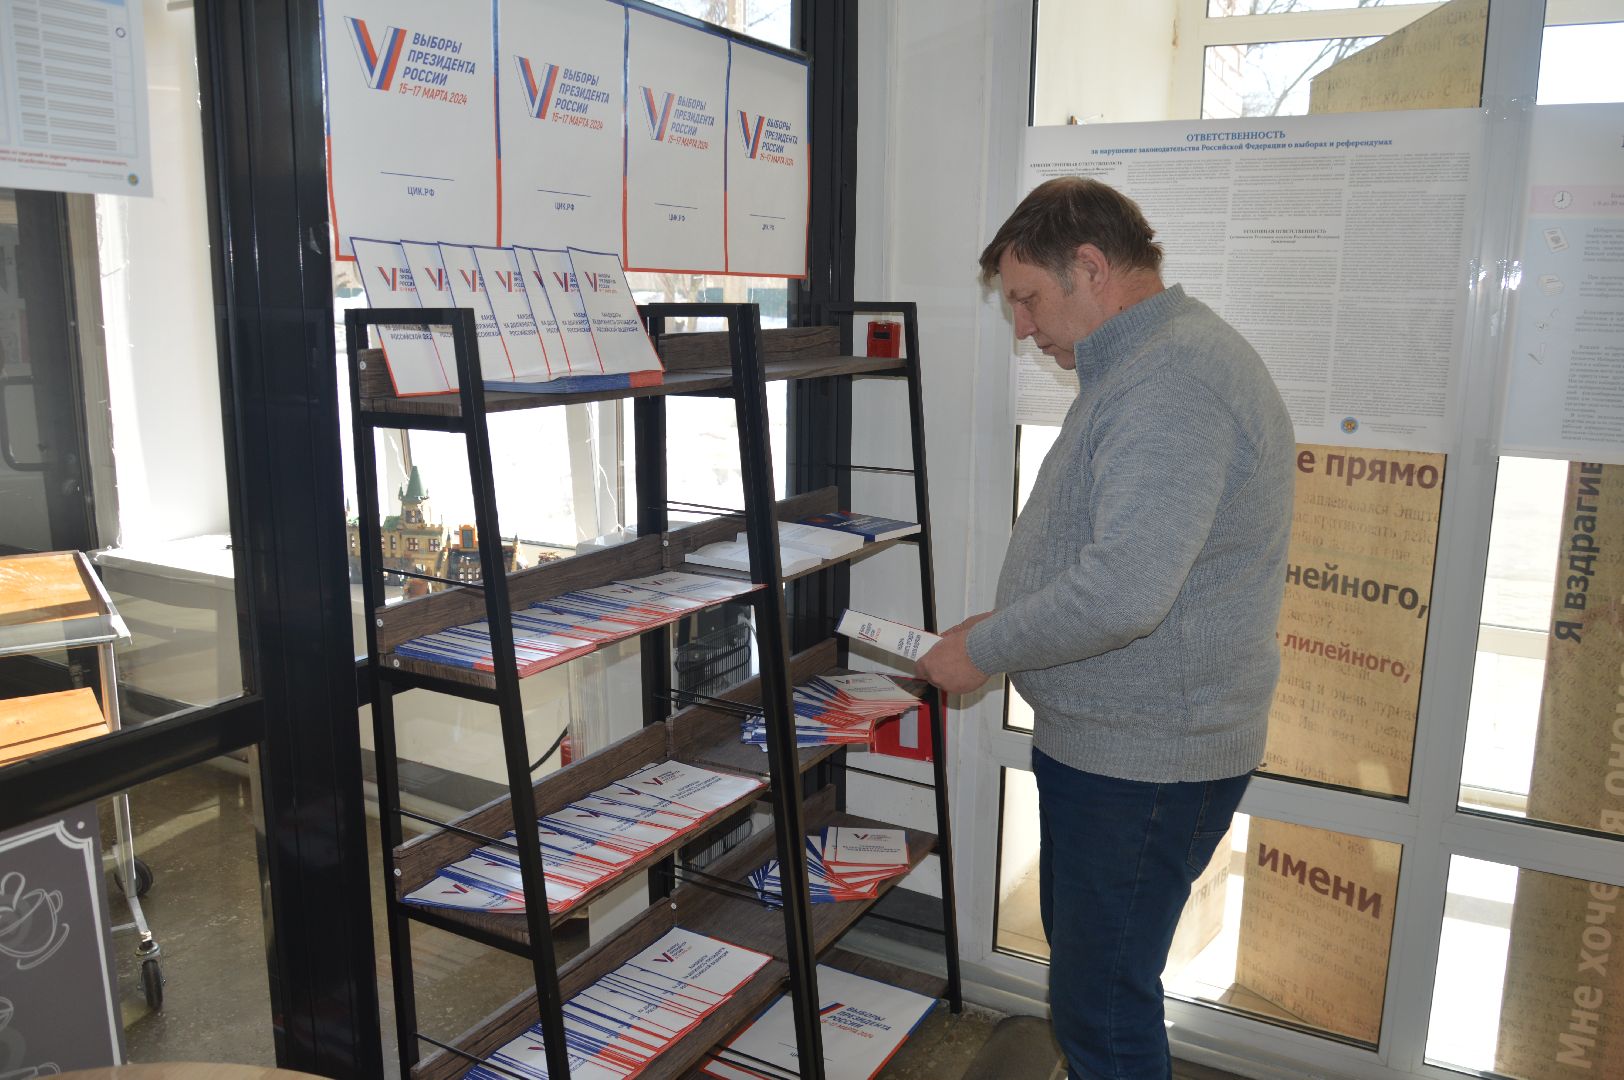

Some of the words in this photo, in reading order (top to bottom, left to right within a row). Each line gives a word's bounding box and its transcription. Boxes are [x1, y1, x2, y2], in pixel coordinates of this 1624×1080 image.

[412, 32, 463, 54] ВЫБОРЫ
[407, 50, 476, 75] ПРЕЗИДЕНТА
[402, 66, 448, 86] РОССИИ
[562, 68, 600, 87] ВЫБОРЫ
[421, 86, 448, 102] МАРТА
[448, 92, 468, 105] 2024
[558, 83, 610, 104] ПРЕЗИДЕНТА
[677, 95, 706, 110] ВЫБОРЫ
[554, 98, 589, 114] РОССИИ
[569, 115, 589, 128] МАРТА
[673, 109, 715, 127] ПРЕЗИДЕНТА
[766, 118, 792, 131] ВЫБОРЫ
[670, 122, 698, 136] РОССИИ
[1186, 130, 1286, 142] ОТВЕТСТВЕННОСТЬ
[761, 141, 785, 154] РОССИИ
[1139, 144, 1200, 153] законодательства
[1202, 142, 1243, 152] Российской
[1244, 141, 1287, 152] Федерации
[1294, 140, 1328, 149] выборах
[1336, 137, 1393, 149] референдумах
[407, 186, 435, 197] ЦИК.РФ
[1326, 453, 1439, 489] прямо
[1554, 620, 1584, 645] Я
[1283, 632, 1411, 684] лилейного,
[1257, 842, 1383, 919] имени
[827, 1014, 865, 1028] РОССИИ
[836, 1010, 892, 1031] ПРЕЗИДЕНТА
[845, 1006, 887, 1022] ВЫБОРЫ
[1555, 985, 1604, 1070] Мне
